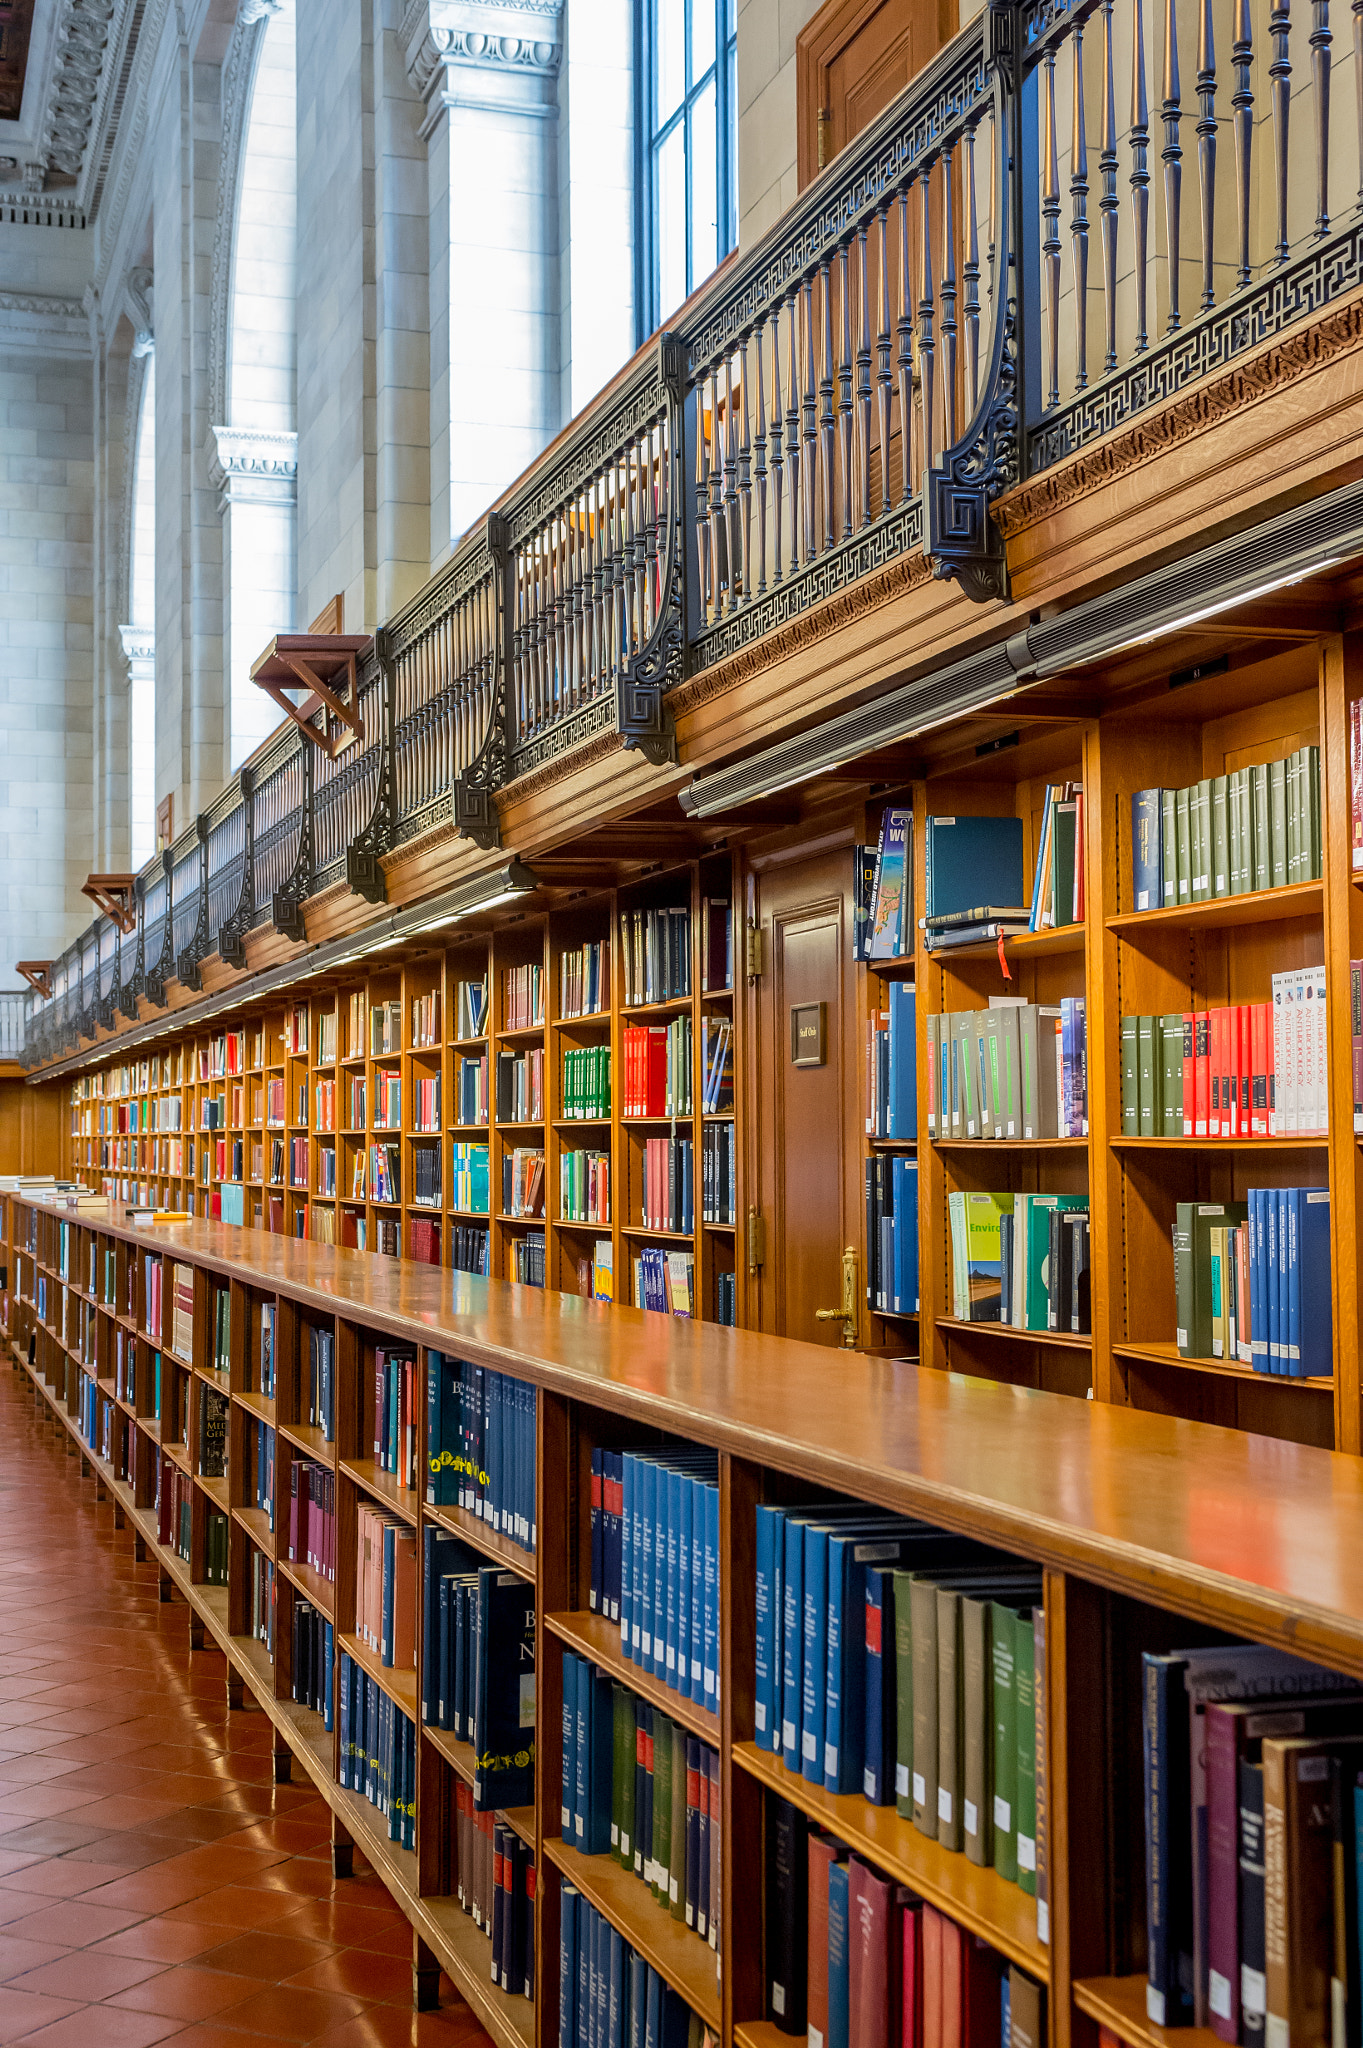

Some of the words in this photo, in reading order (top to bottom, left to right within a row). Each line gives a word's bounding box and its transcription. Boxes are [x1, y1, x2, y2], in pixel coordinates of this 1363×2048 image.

[876, 853, 881, 864] OF
[1284, 1010, 1292, 1088] ANTHROPOLOGY
[1305, 1007, 1313, 1087] ANTHROPOLOGY
